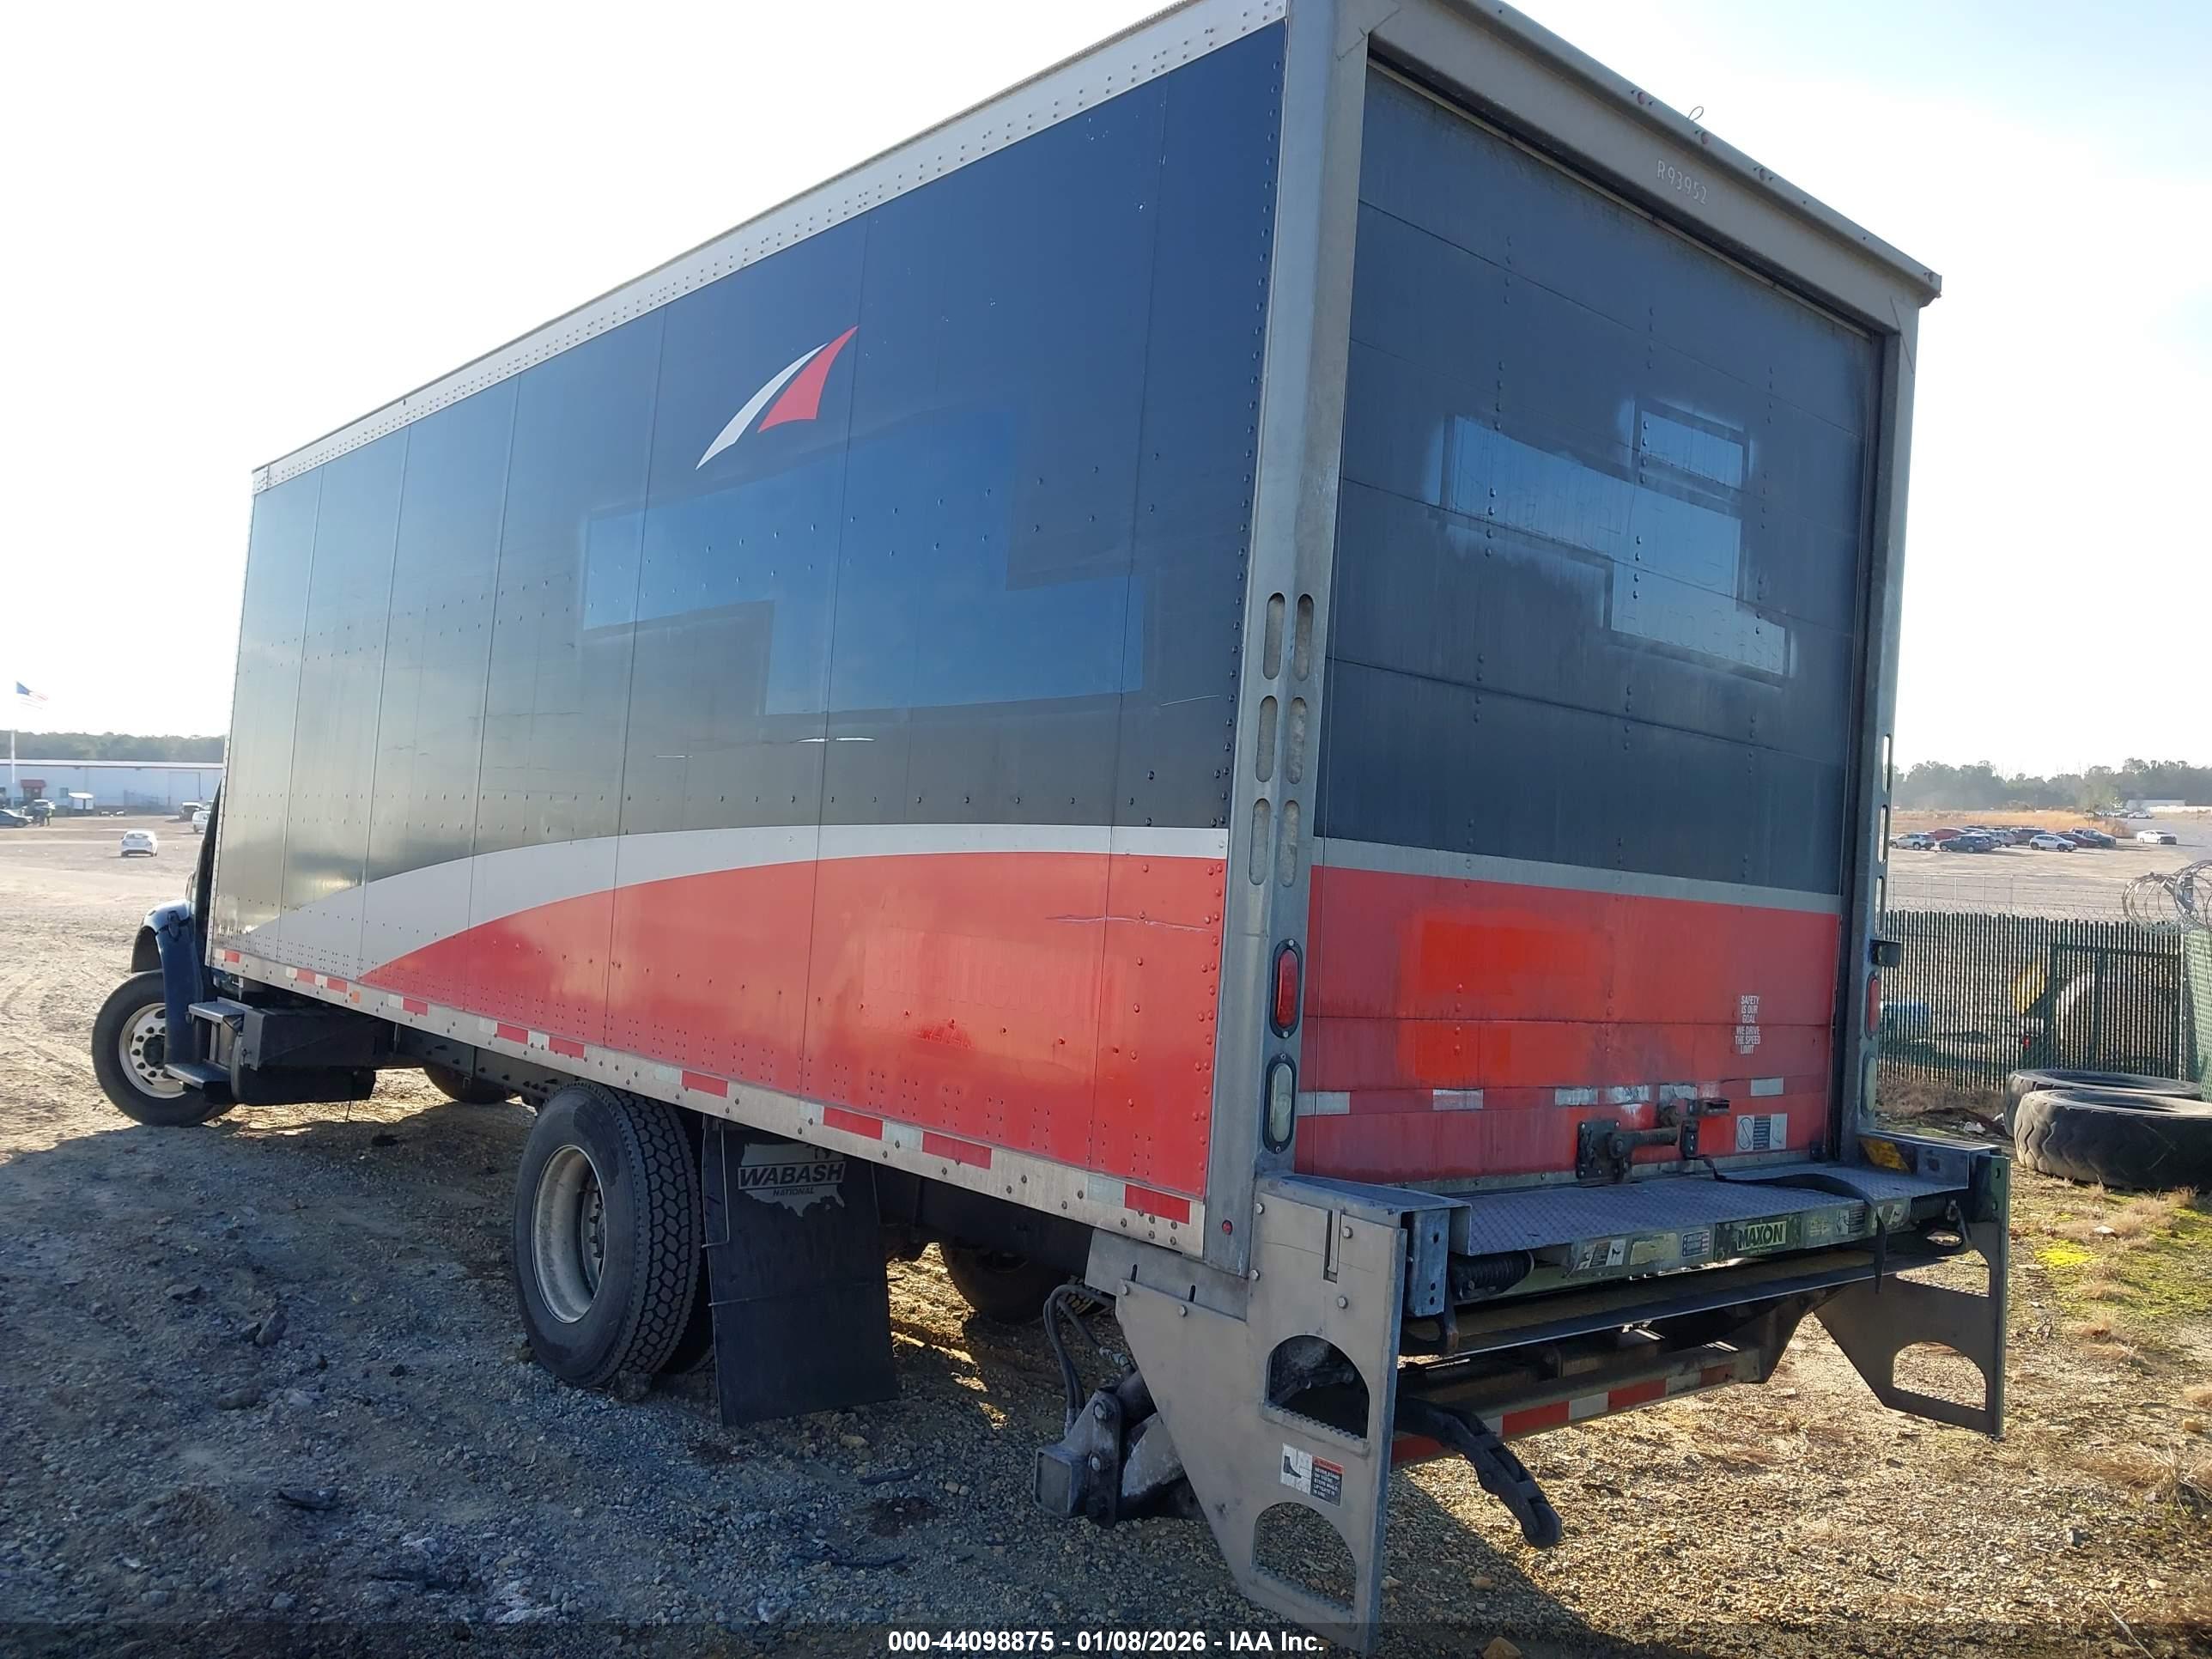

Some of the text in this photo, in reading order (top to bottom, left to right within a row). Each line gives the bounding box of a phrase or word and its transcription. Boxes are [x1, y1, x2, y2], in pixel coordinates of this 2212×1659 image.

[1657, 159, 1708, 205] R93952
[1741, 995, 1759, 1005] SAFETY
[1741, 1005, 1758, 1014] IS OUR
[1742, 1014, 1755, 1024] GOAL
[1735, 1035, 1760, 1045] THE SPEED
[1741, 1044, 1754, 1054] LIMIT
[740, 1163, 843, 1186] WABASH
[774, 1188, 814, 1196] NATIONAL
[1738, 1224, 1784, 1249] MAXON
